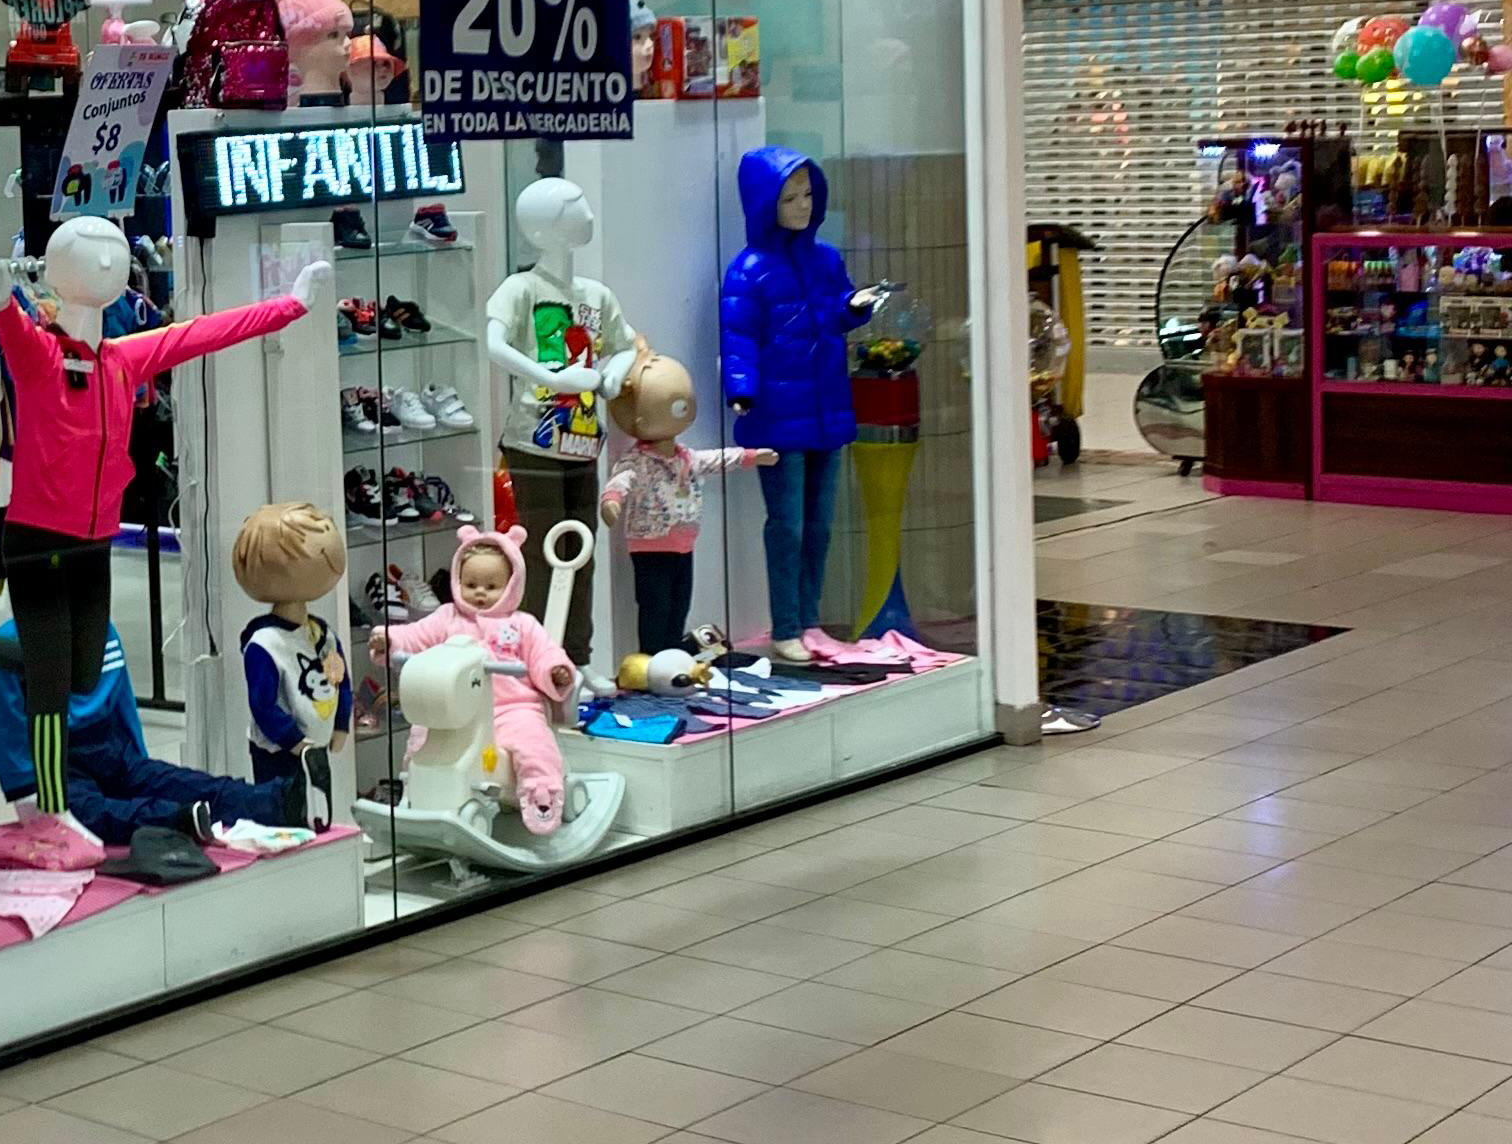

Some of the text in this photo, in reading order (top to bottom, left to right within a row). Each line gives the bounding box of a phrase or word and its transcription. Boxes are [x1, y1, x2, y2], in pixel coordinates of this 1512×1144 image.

[90, 71, 155, 90] OFERTAS
[424, 69, 628, 103] DE DESCUENTO
[83, 91, 147, 120] Conjuntos
[91, 121, 122, 155] $8
[424, 113, 446, 134] EN
[451, 112, 499, 133] TODA
[504, 111, 528, 132] LA
[215, 123, 462, 206] INFANTIL
